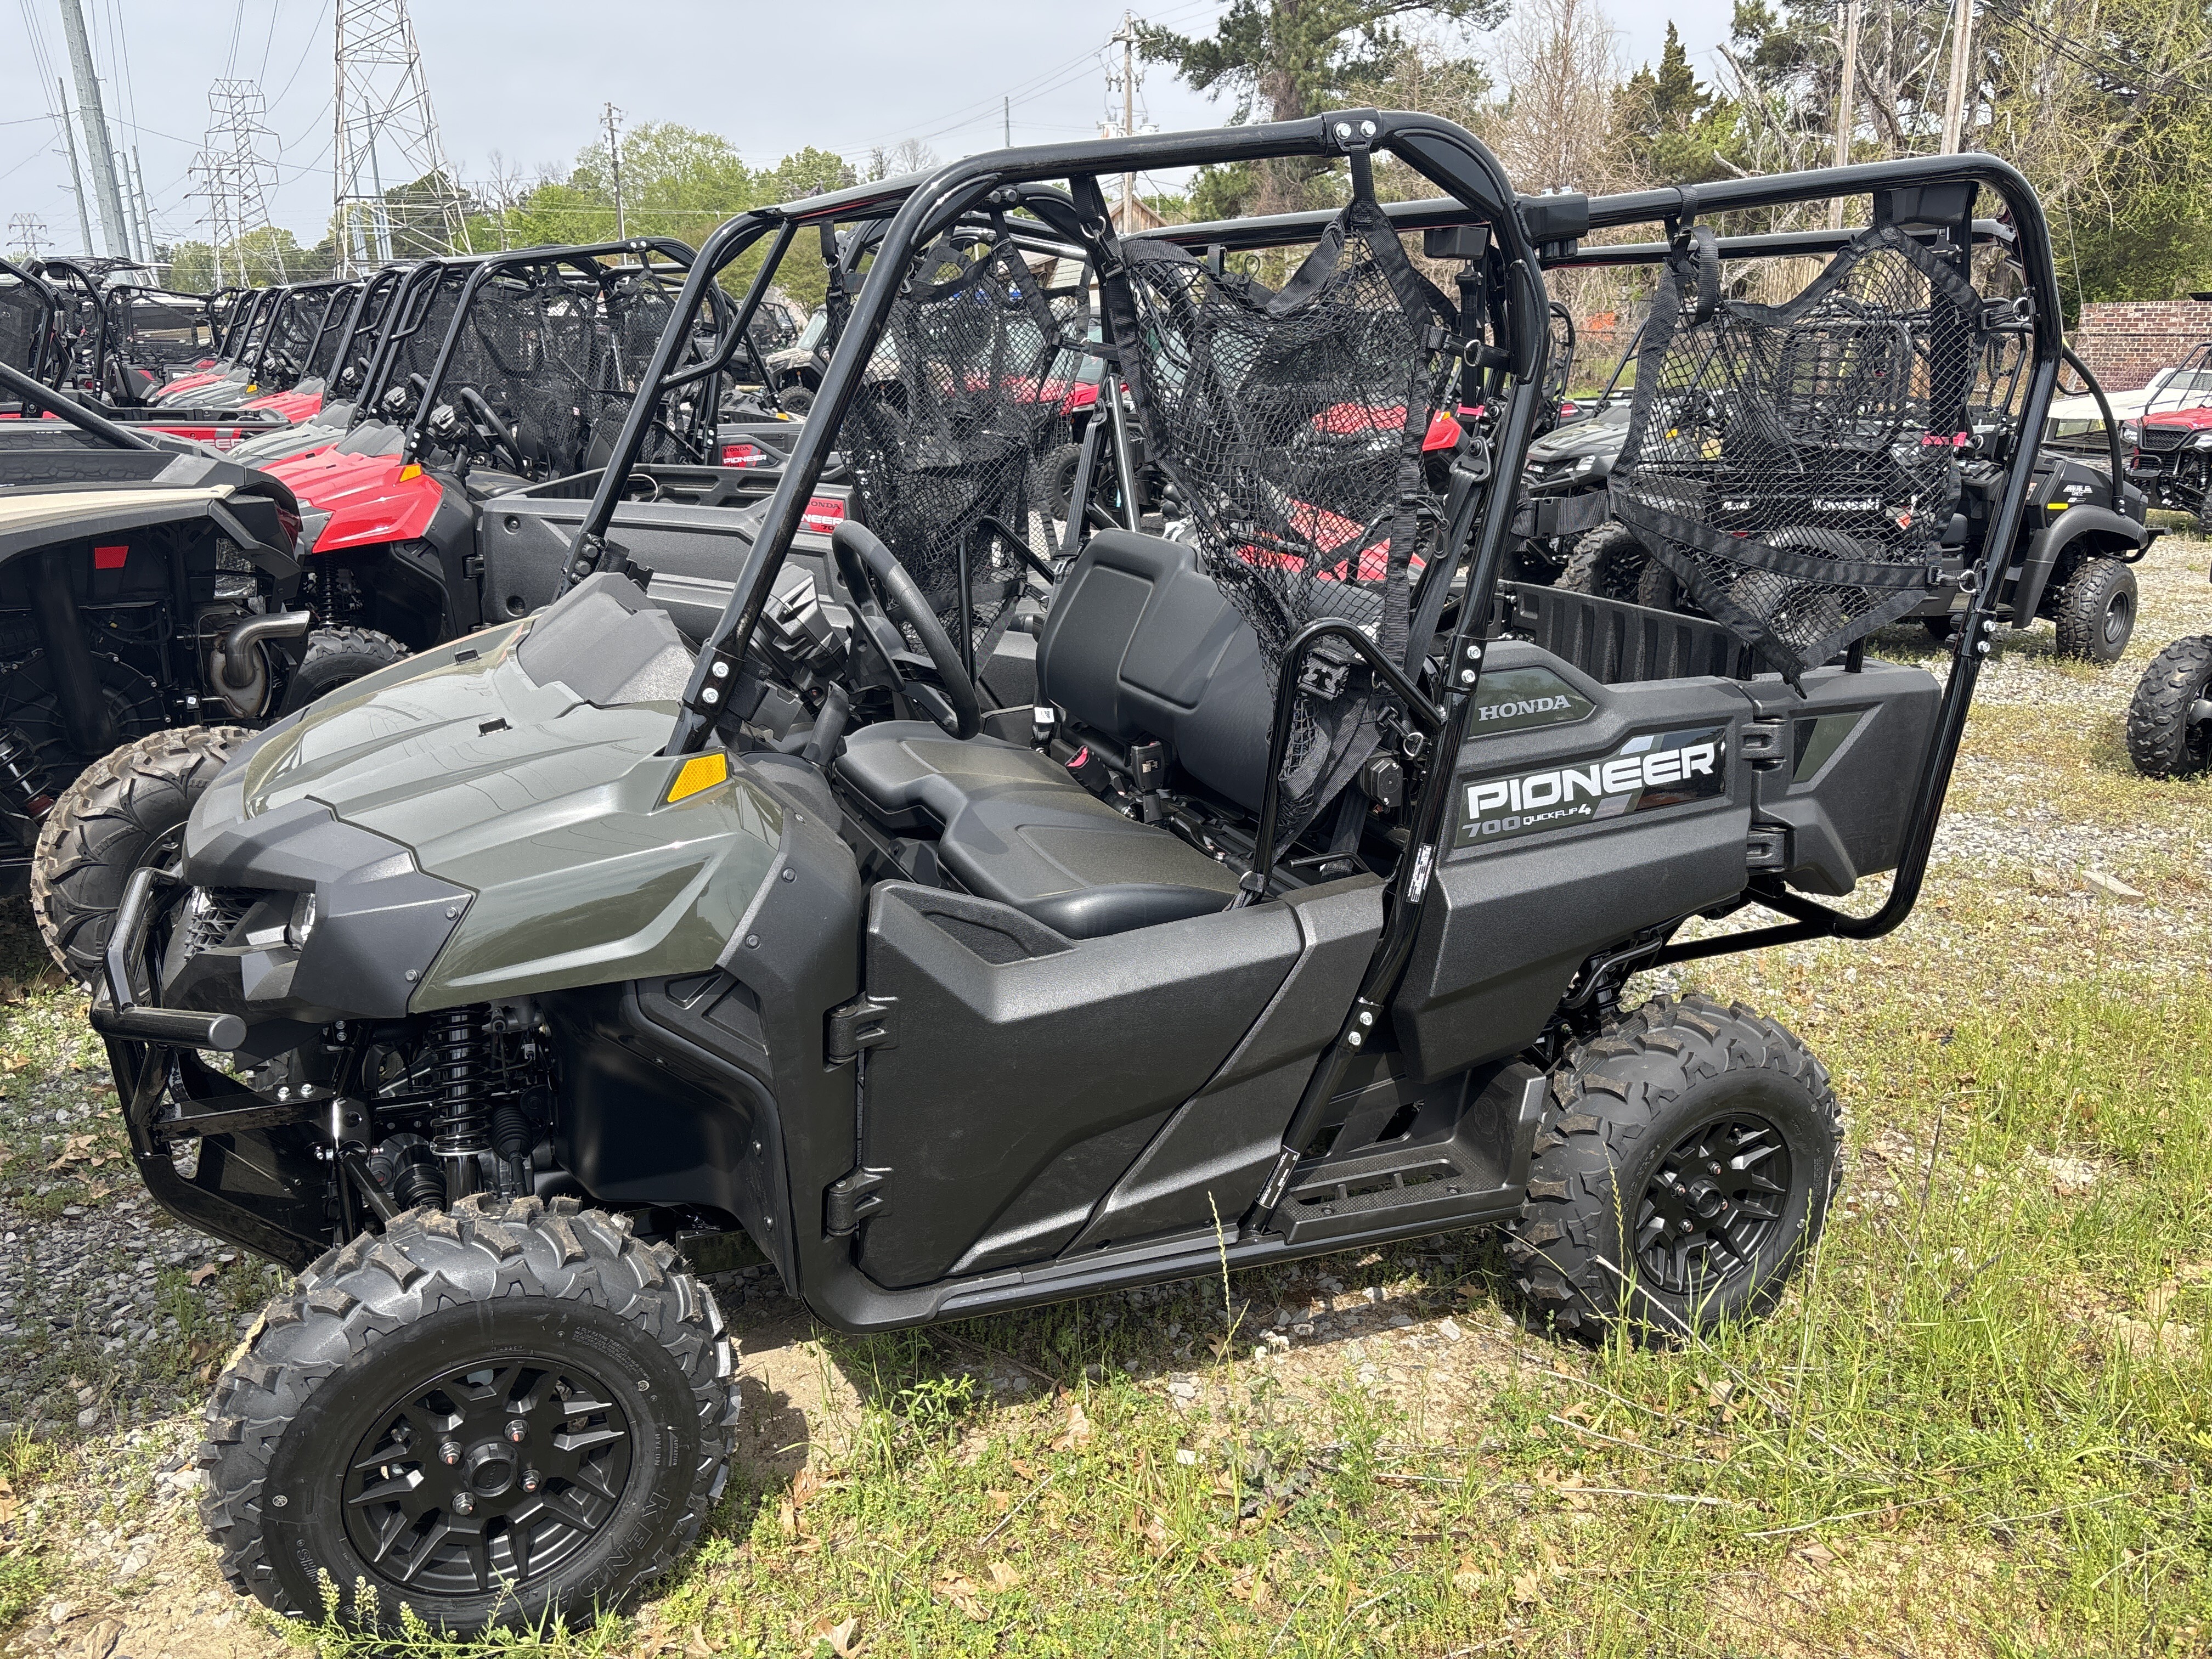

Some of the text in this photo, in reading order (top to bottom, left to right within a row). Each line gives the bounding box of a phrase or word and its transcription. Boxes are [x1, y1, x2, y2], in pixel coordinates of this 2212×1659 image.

[723, 454, 767, 464] PIONEER
[808, 501, 842, 510] ONDA
[1812, 498, 1881, 511] Kawasaki
[800, 514, 844, 525] NEER
[1479, 695, 1571, 721] HONDA
[1467, 742, 1715, 820] PIONEER
[1462, 815, 1521, 838] 700
[654, 1434, 662, 1466] NYLON
[549, 1492, 672, 1615] KENDA
